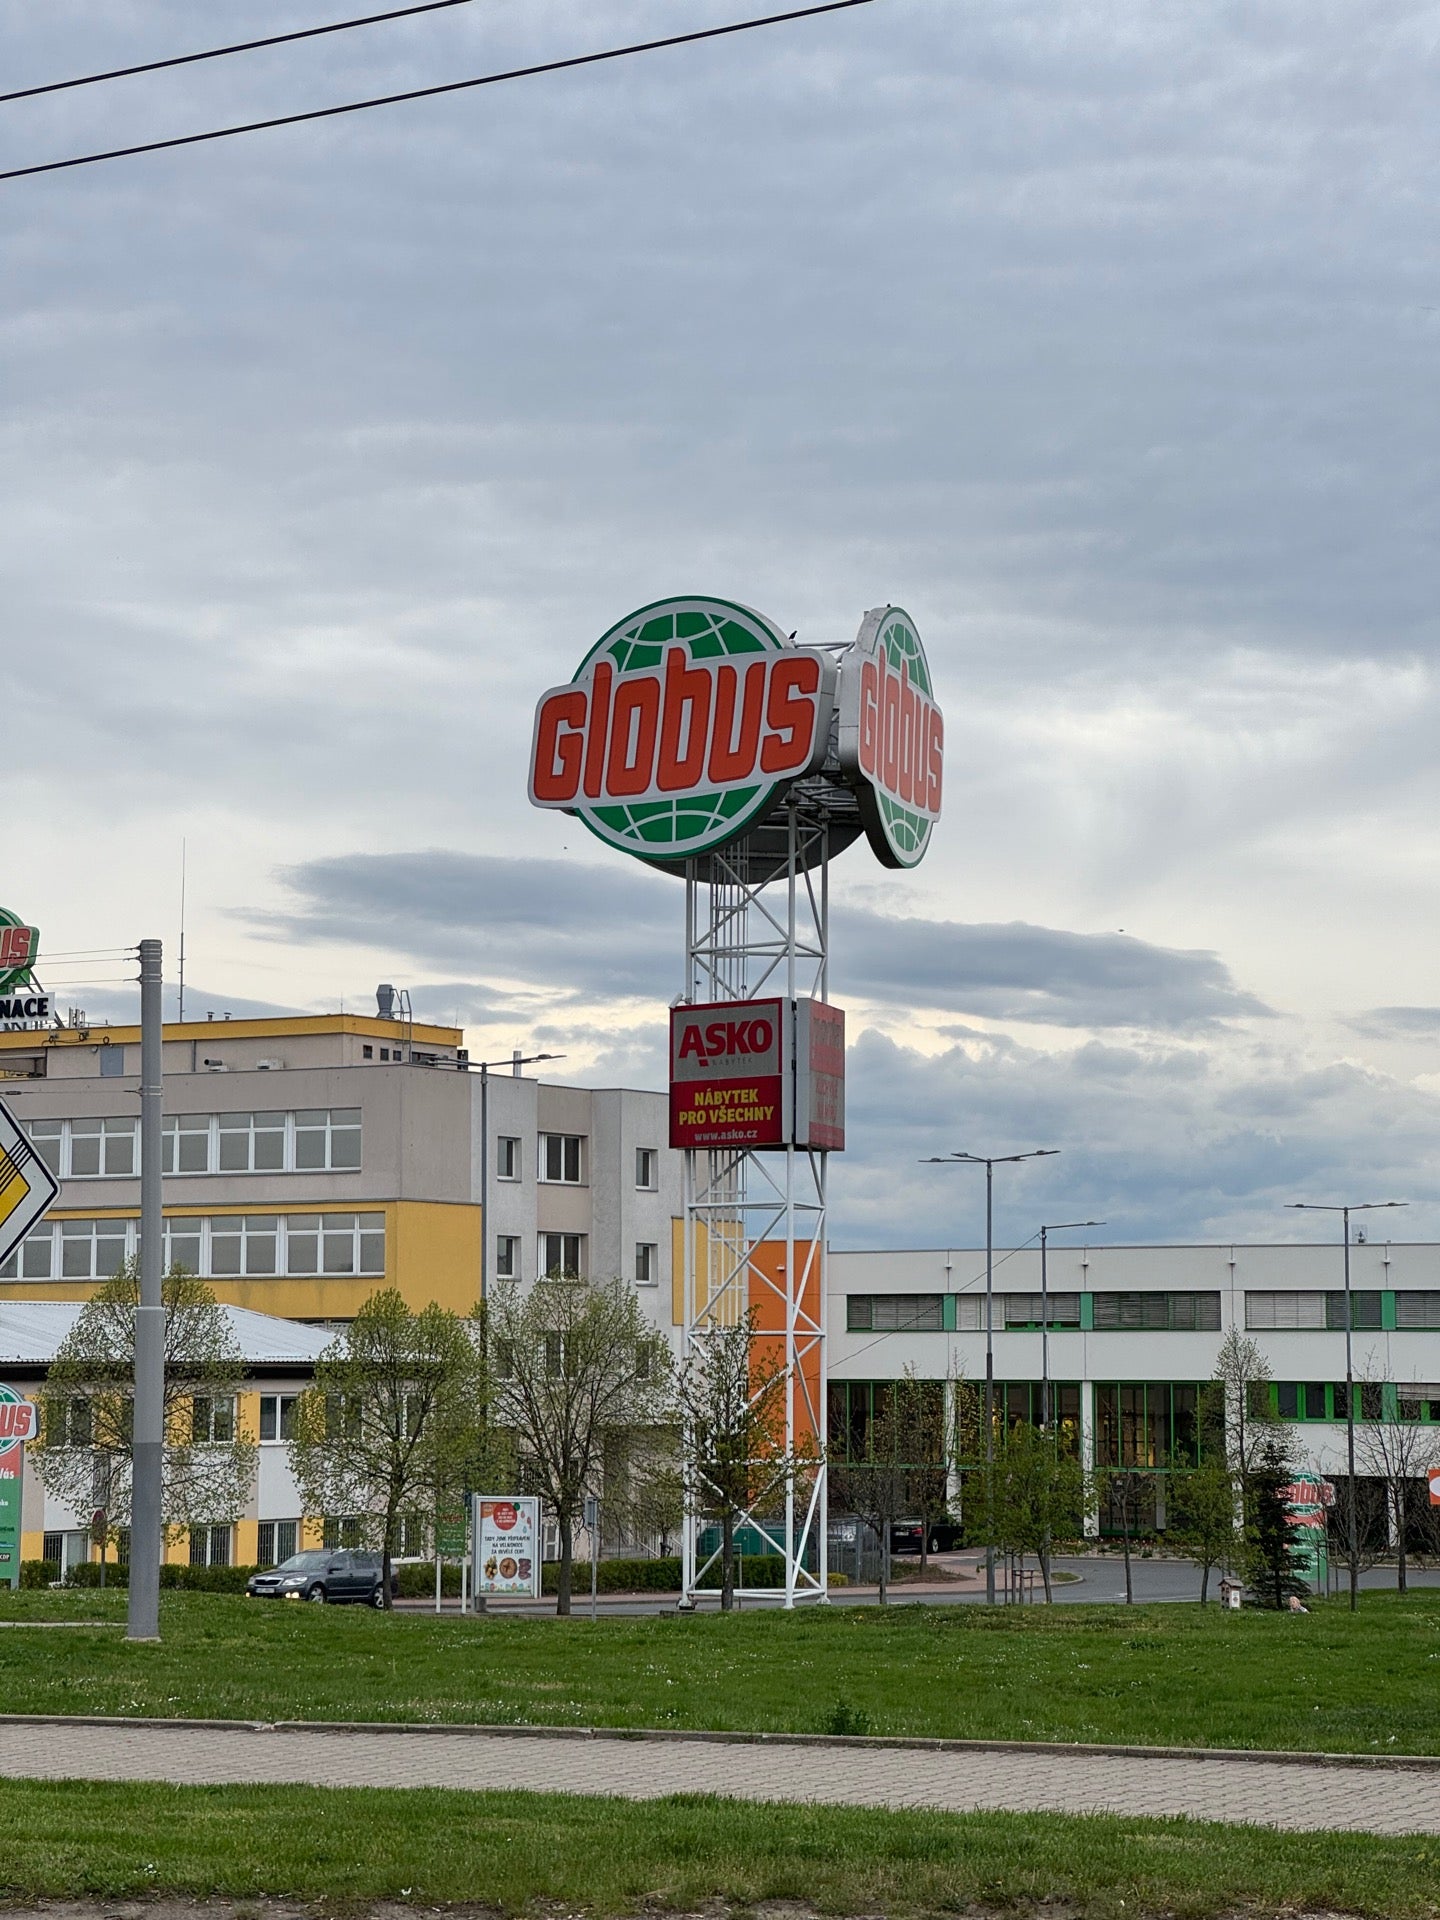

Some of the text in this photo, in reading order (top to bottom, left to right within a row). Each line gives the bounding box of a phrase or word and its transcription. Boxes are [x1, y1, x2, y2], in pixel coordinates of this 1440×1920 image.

[533, 647, 820, 801] Globus
[859, 645, 943, 814] Globus
[678, 1019, 773, 1060] ASKO
[694, 1088, 759, 1106] NÁBYTEK
[679, 1105, 774, 1125] PRO VŠECHNY
[694, 1129, 758, 1141] www.asko.cz
